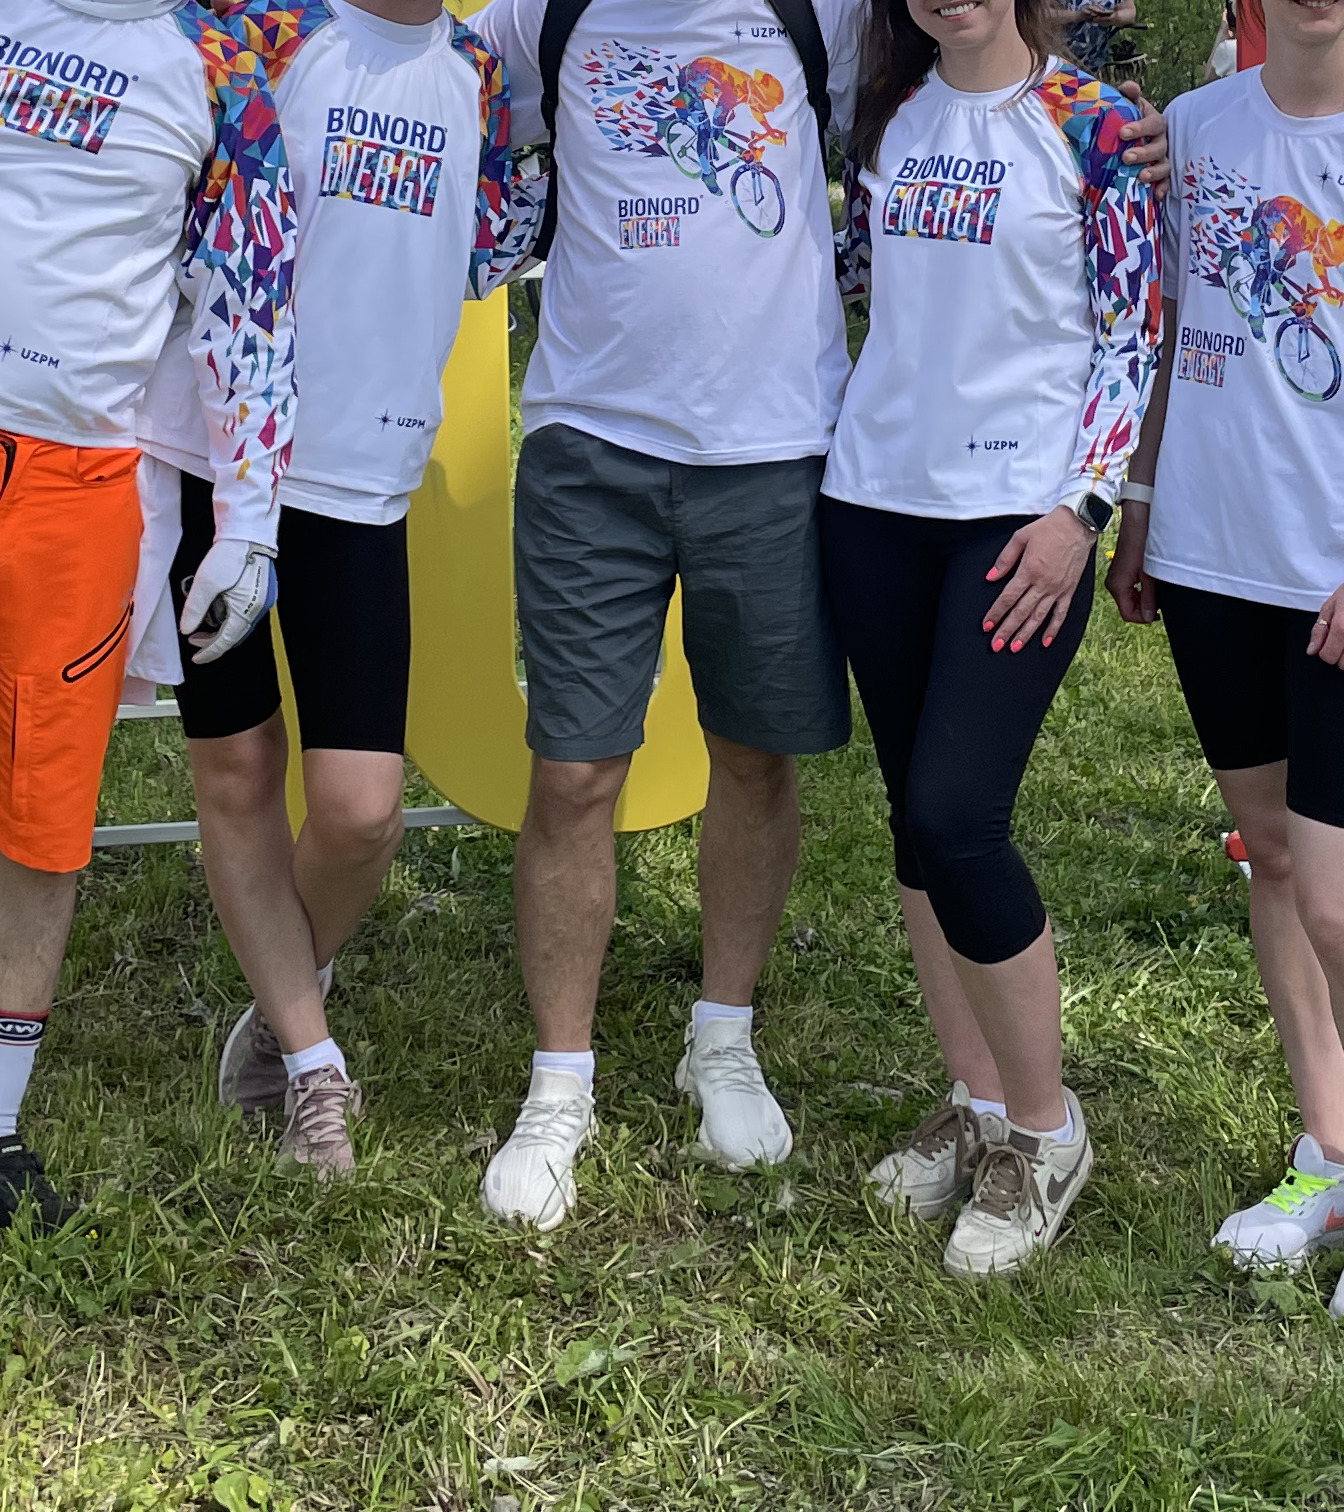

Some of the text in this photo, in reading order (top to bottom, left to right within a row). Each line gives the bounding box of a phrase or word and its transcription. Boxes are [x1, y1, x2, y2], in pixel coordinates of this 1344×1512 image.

[751, 27, 787, 38] UZPM
[326, 105, 446, 153] BIONORD
[896, 154, 1006, 185] BIONORD
[618, 197, 699, 218] BIONORD
[884, 184, 997, 242] ENERGY
[620, 218, 678, 248] ENERGY
[1181, 326, 1245, 357] BIONORD
[20, 347, 60, 369] UZPM
[397, 416, 426, 429] UZPM
[984, 440, 1018, 451] UZPM
